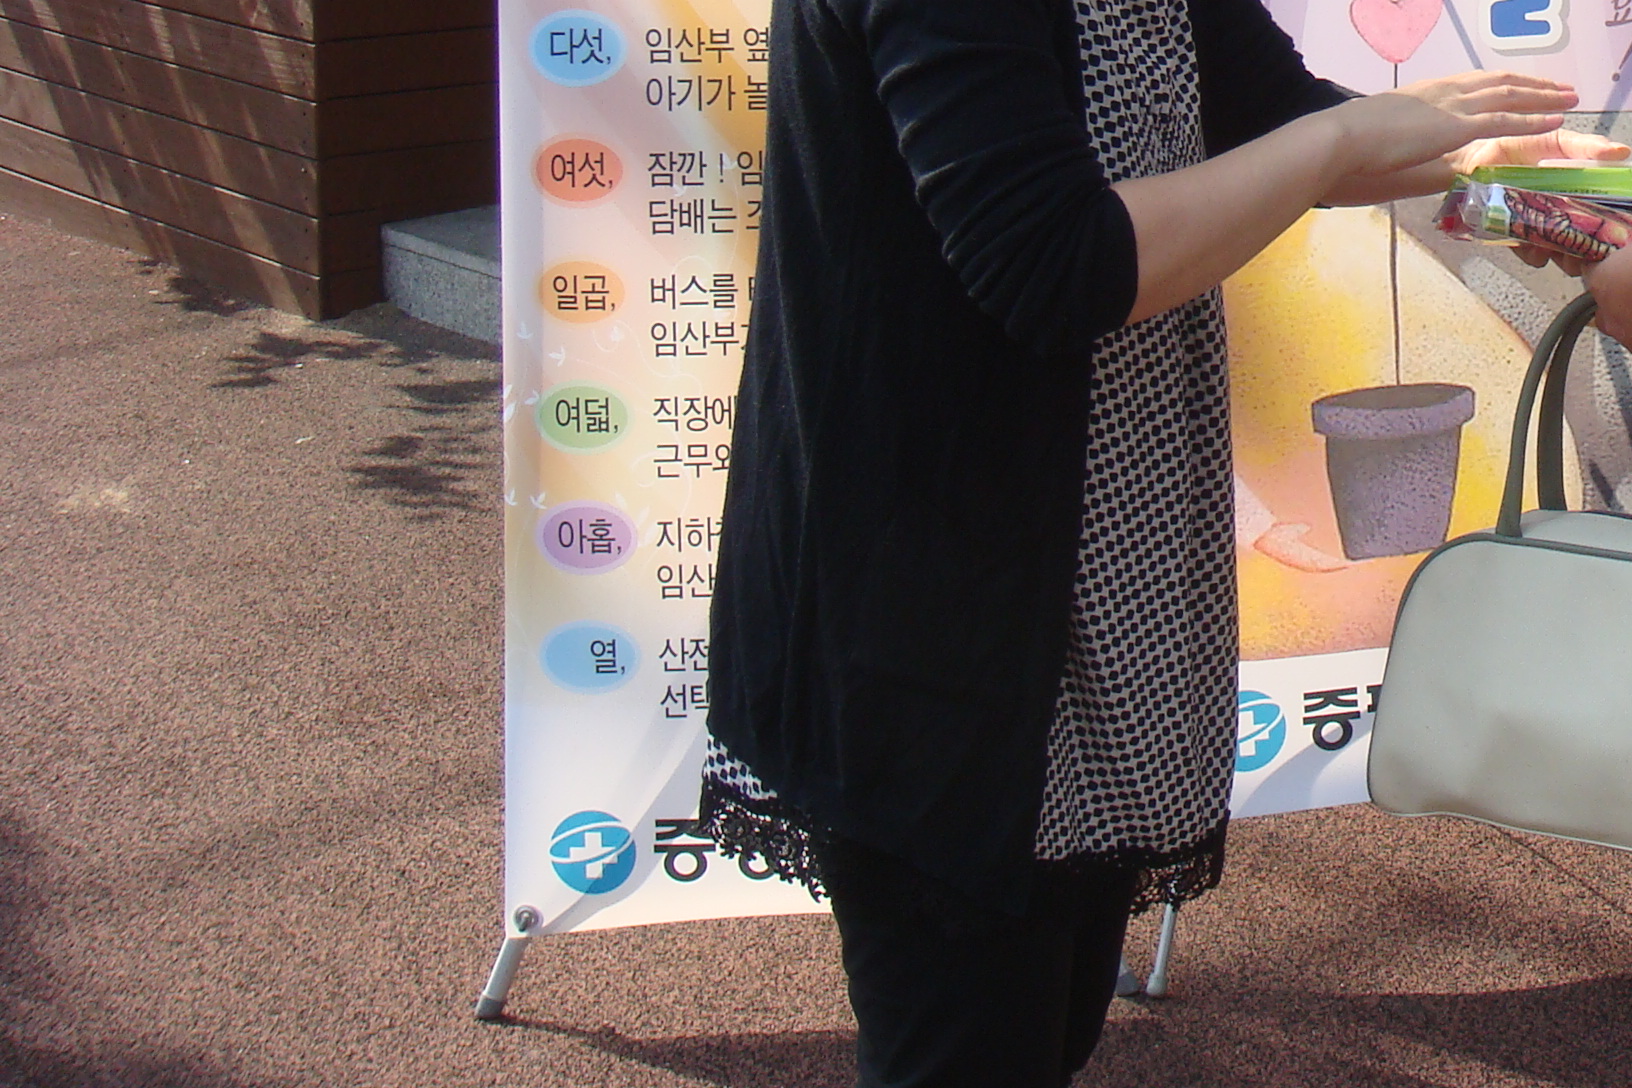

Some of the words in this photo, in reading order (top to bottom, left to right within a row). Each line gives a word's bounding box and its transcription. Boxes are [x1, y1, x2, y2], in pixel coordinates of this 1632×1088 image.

[549, 27, 611, 65] 다섯,
[645, 27, 735, 64] 임산부
[645, 75, 736, 112] 아기가
[550, 151, 614, 190] 여섯,
[647, 151, 708, 188] 잠깐
[648, 199, 737, 235] 담배는
[553, 274, 617, 312] 일곱,
[650, 273, 739, 310] 버스를
[555, 396, 619, 434] 여덟,
[557, 517, 623, 556] 아홉,
[656, 517, 723, 553] 지하
[590, 638, 626, 676] 열,
[1302, 683, 1384, 752] 증
